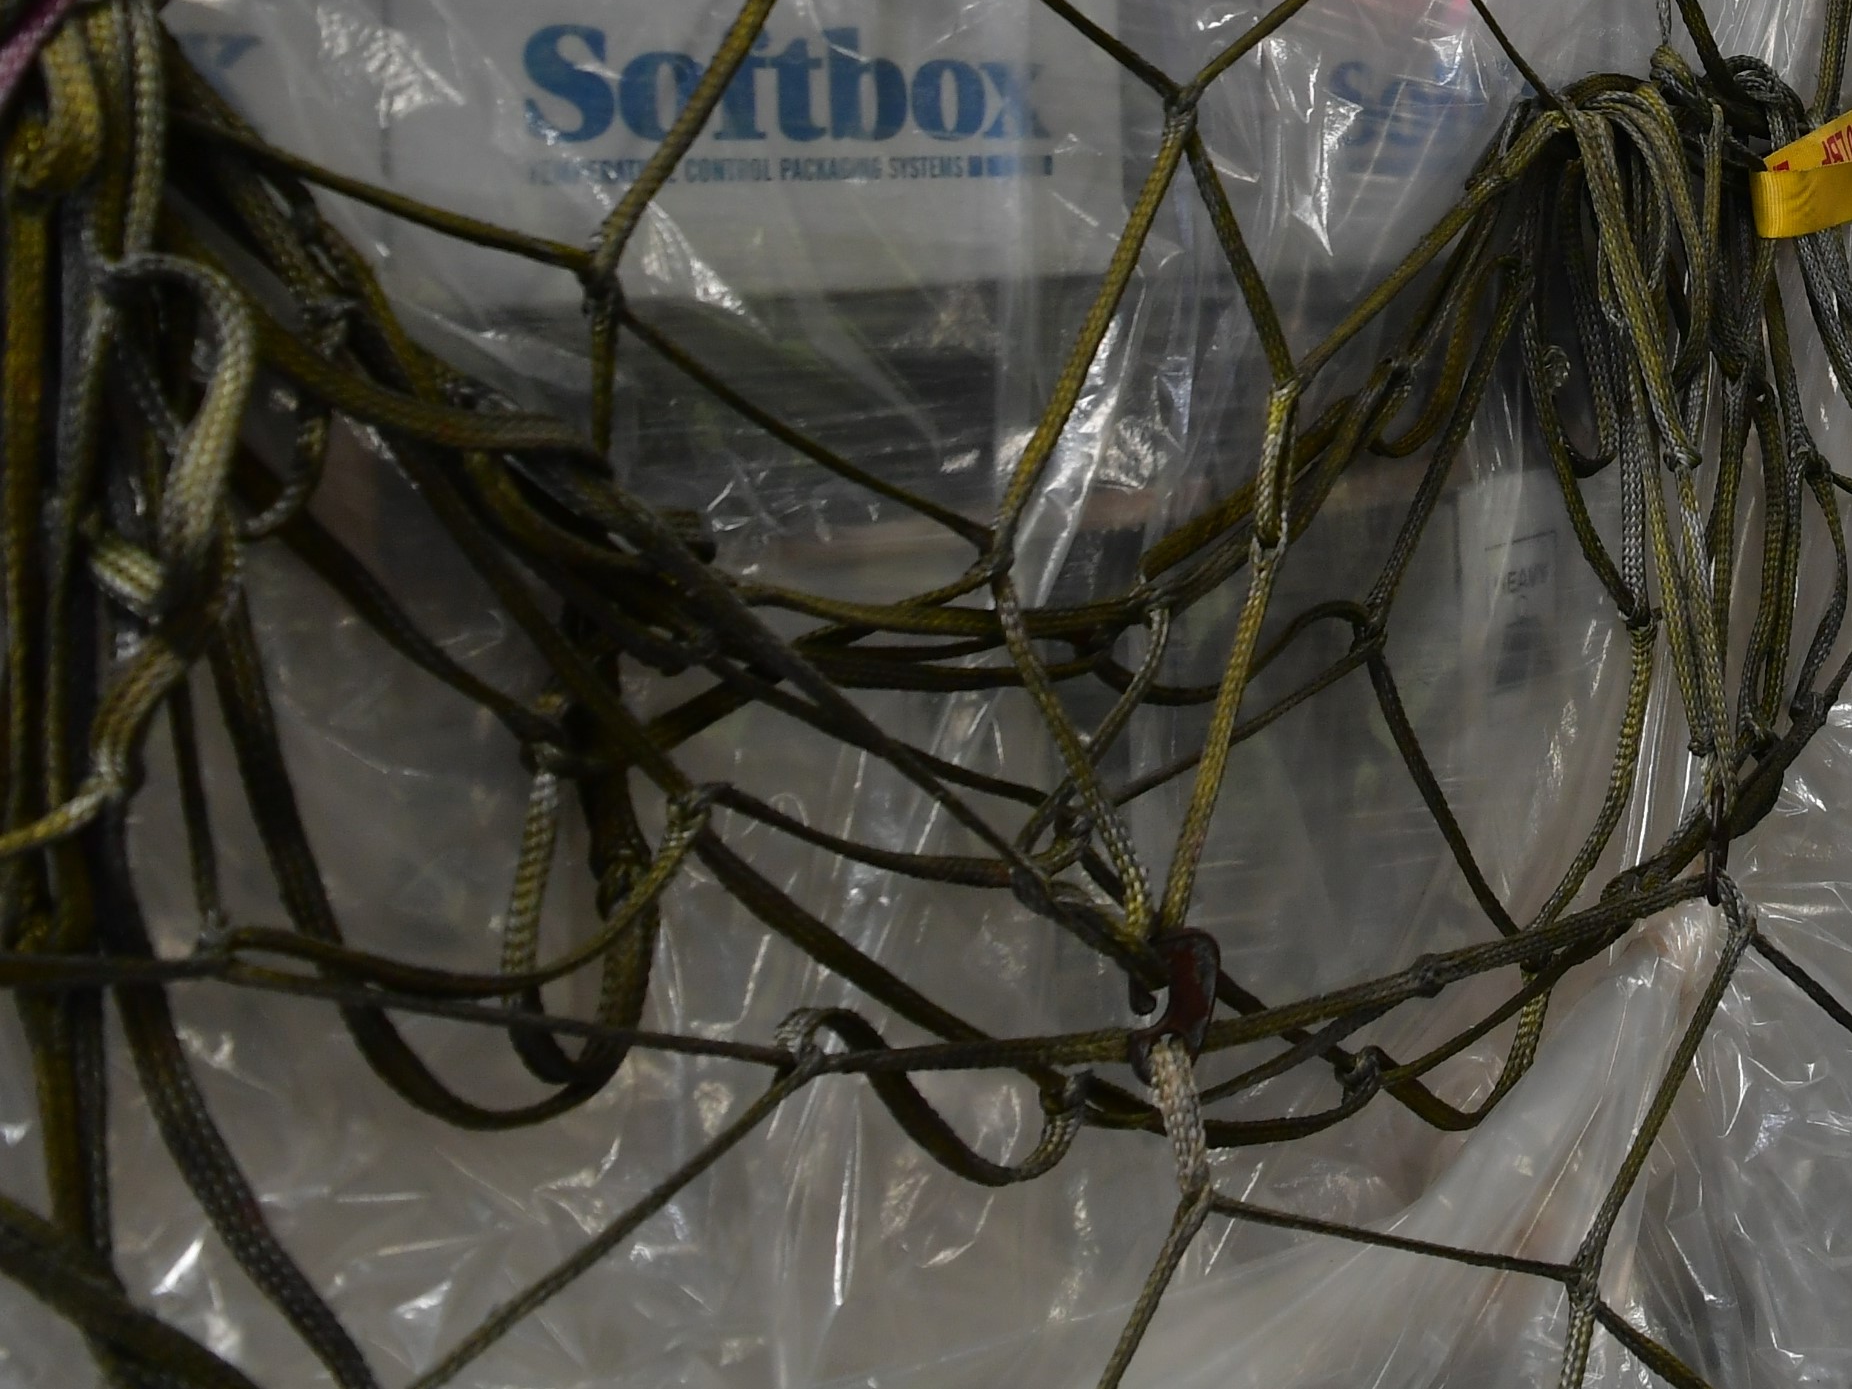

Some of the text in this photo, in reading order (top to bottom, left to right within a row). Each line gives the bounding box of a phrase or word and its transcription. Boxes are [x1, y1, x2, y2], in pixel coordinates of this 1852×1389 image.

[522, 24, 1052, 142] Softbox
[779, 156, 882, 181] PACKAGING
[889, 155, 964, 179] SYSTEMS
